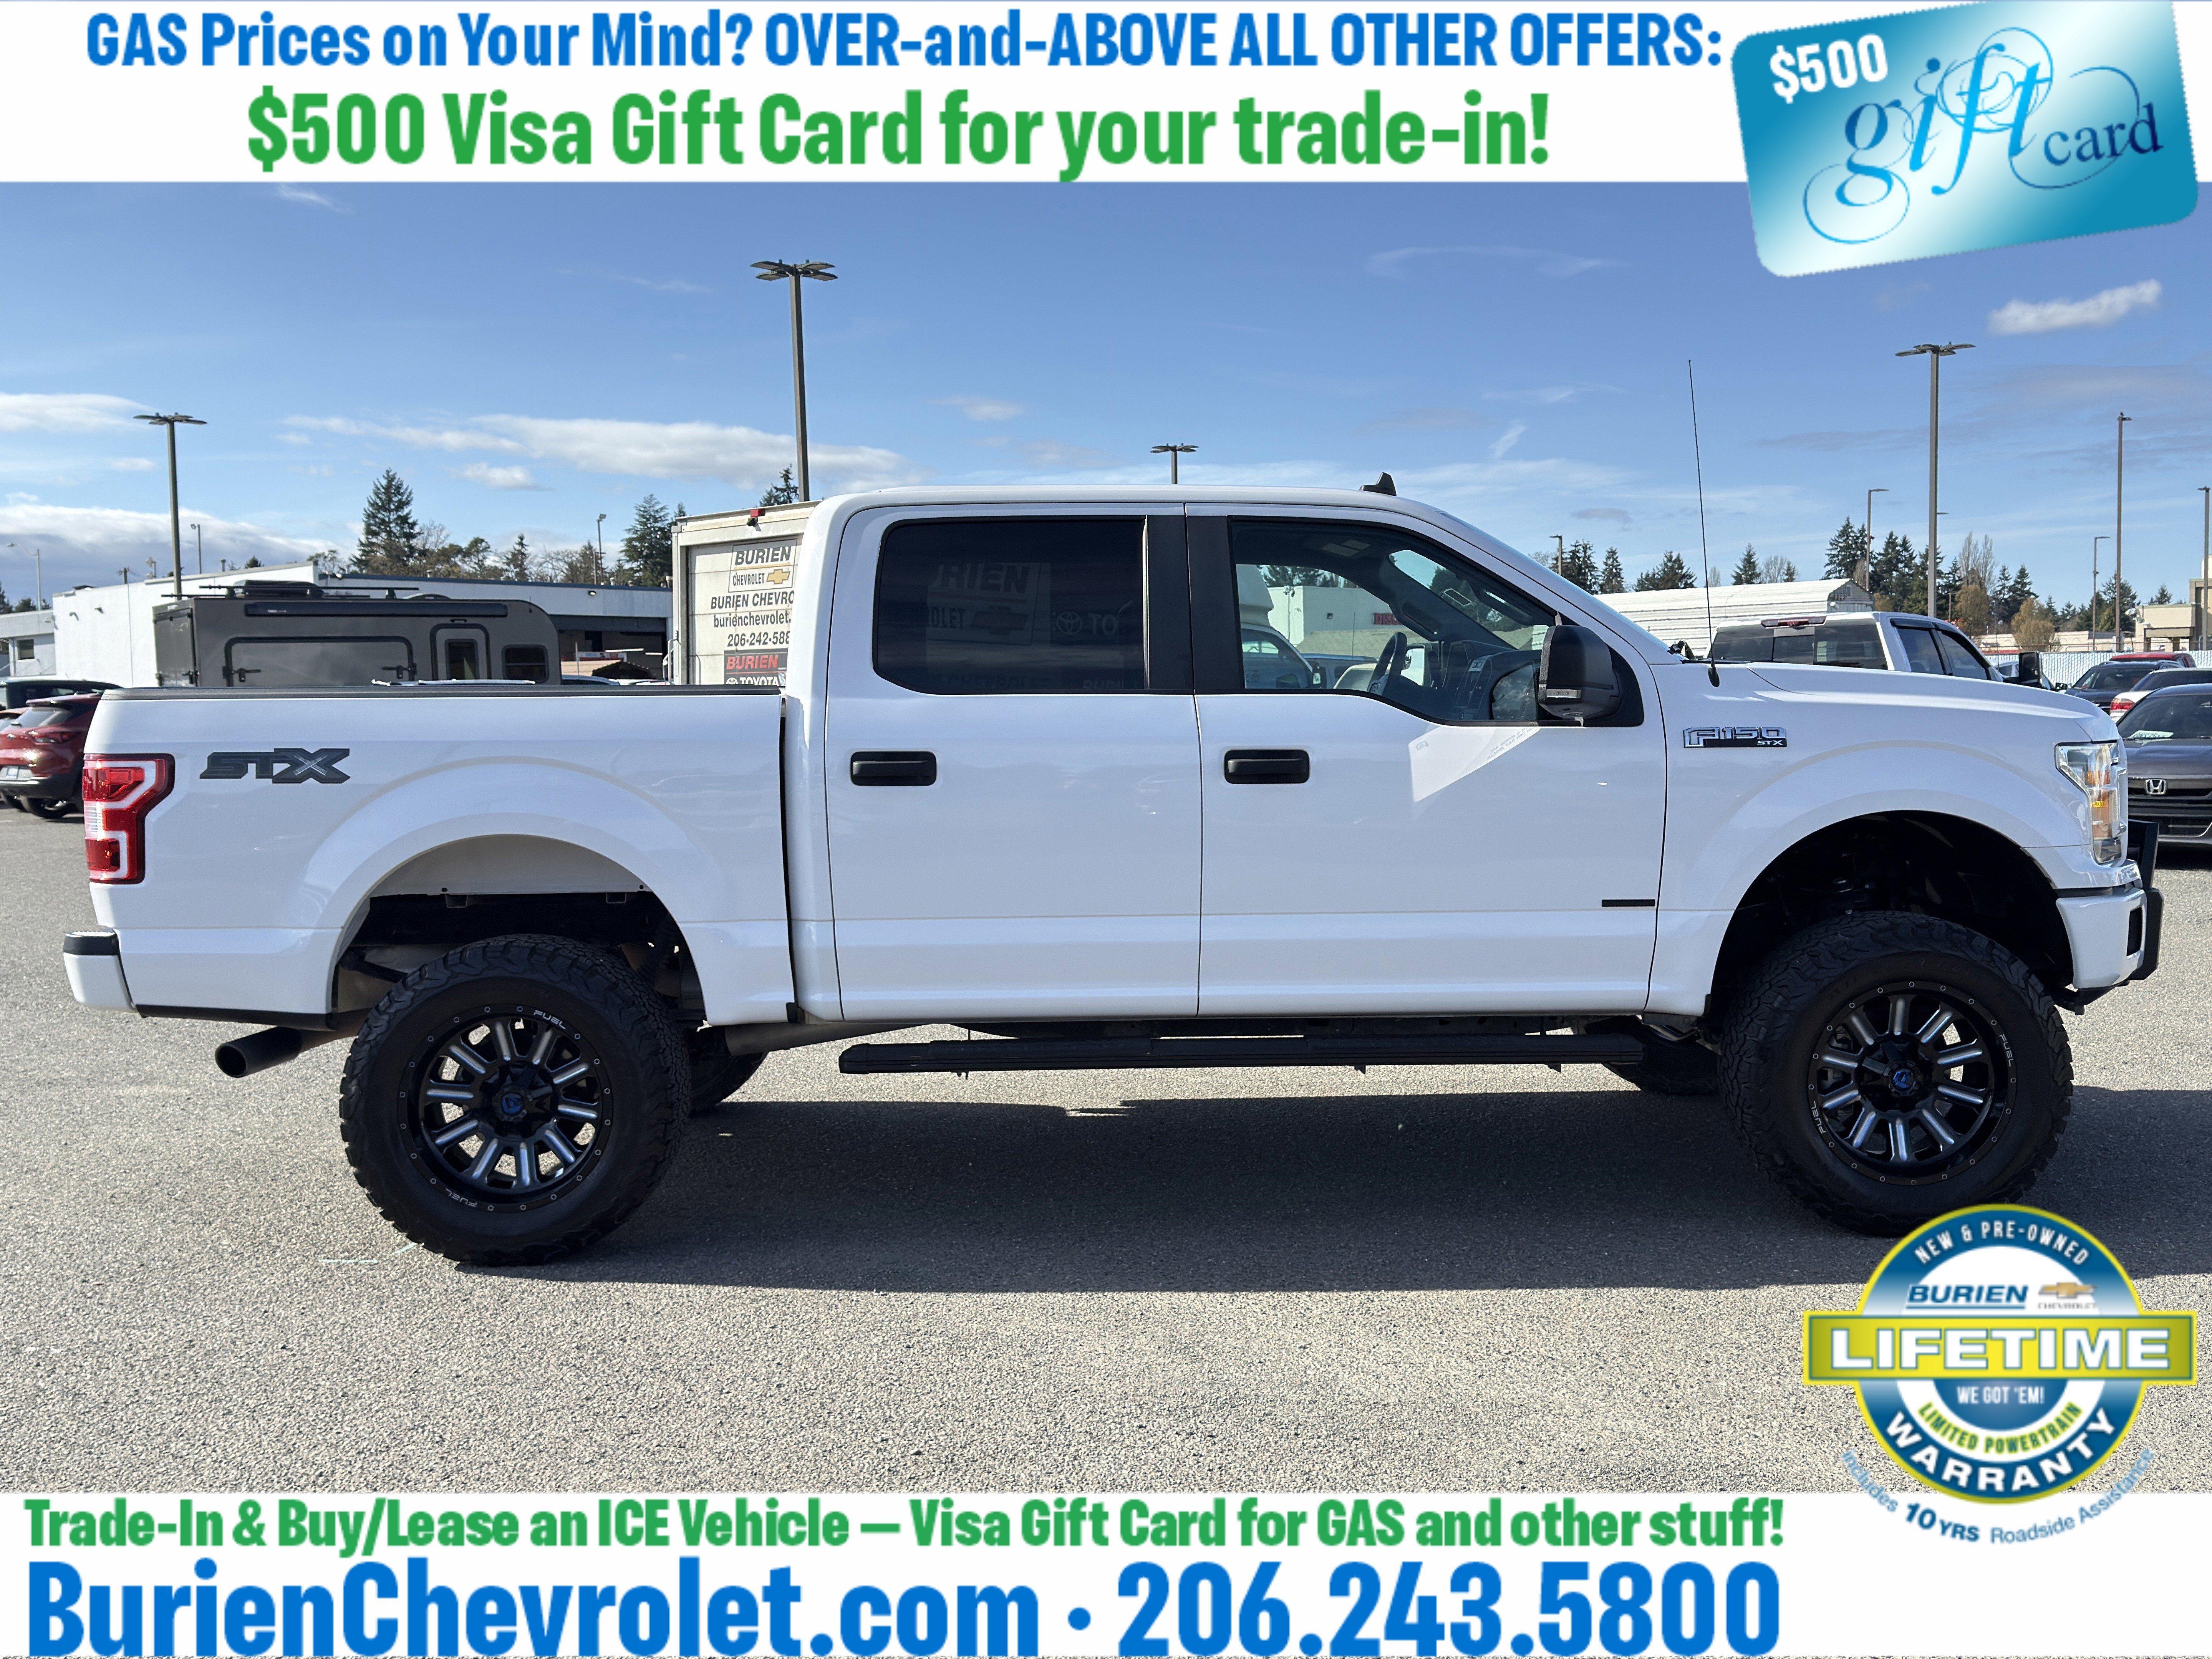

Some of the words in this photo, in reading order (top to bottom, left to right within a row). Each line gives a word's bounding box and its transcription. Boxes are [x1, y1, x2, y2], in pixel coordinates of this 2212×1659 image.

[735, 546, 792, 566] BURIEN
[733, 573, 765, 586] CHEVROLET
[711, 594, 749, 609] BURIEN
[726, 654, 779, 669] BURIEN
[199, 748, 351, 784] STX
[534, 1010, 566, 1030] FUEL
[1999, 1033, 2013, 1067] FUEL
[1811, 1100, 1826, 1134] FUEL
[446, 1188, 478, 1208] FUEL
